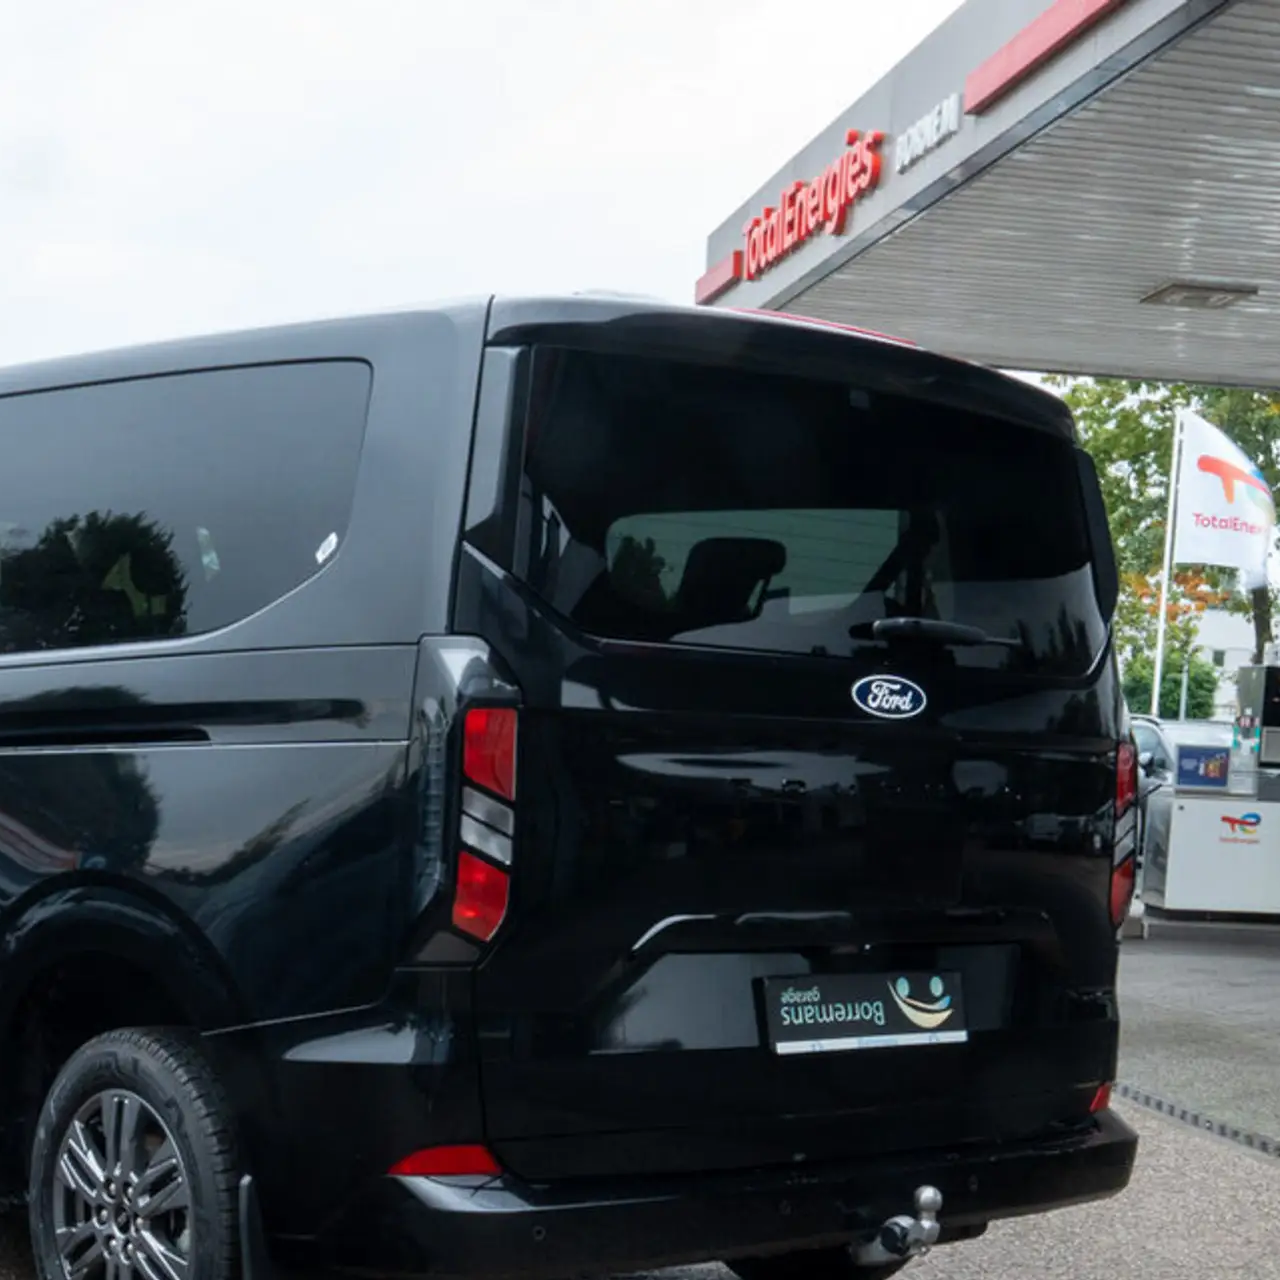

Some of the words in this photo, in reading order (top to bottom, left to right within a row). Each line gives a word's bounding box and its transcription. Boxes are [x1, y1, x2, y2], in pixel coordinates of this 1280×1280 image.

[743, 129, 884, 280] TotalEnergies
[867, 680, 913, 710] Ford
[780, 985, 821, 1004] garage
[780, 1000, 886, 1026] Borremans
